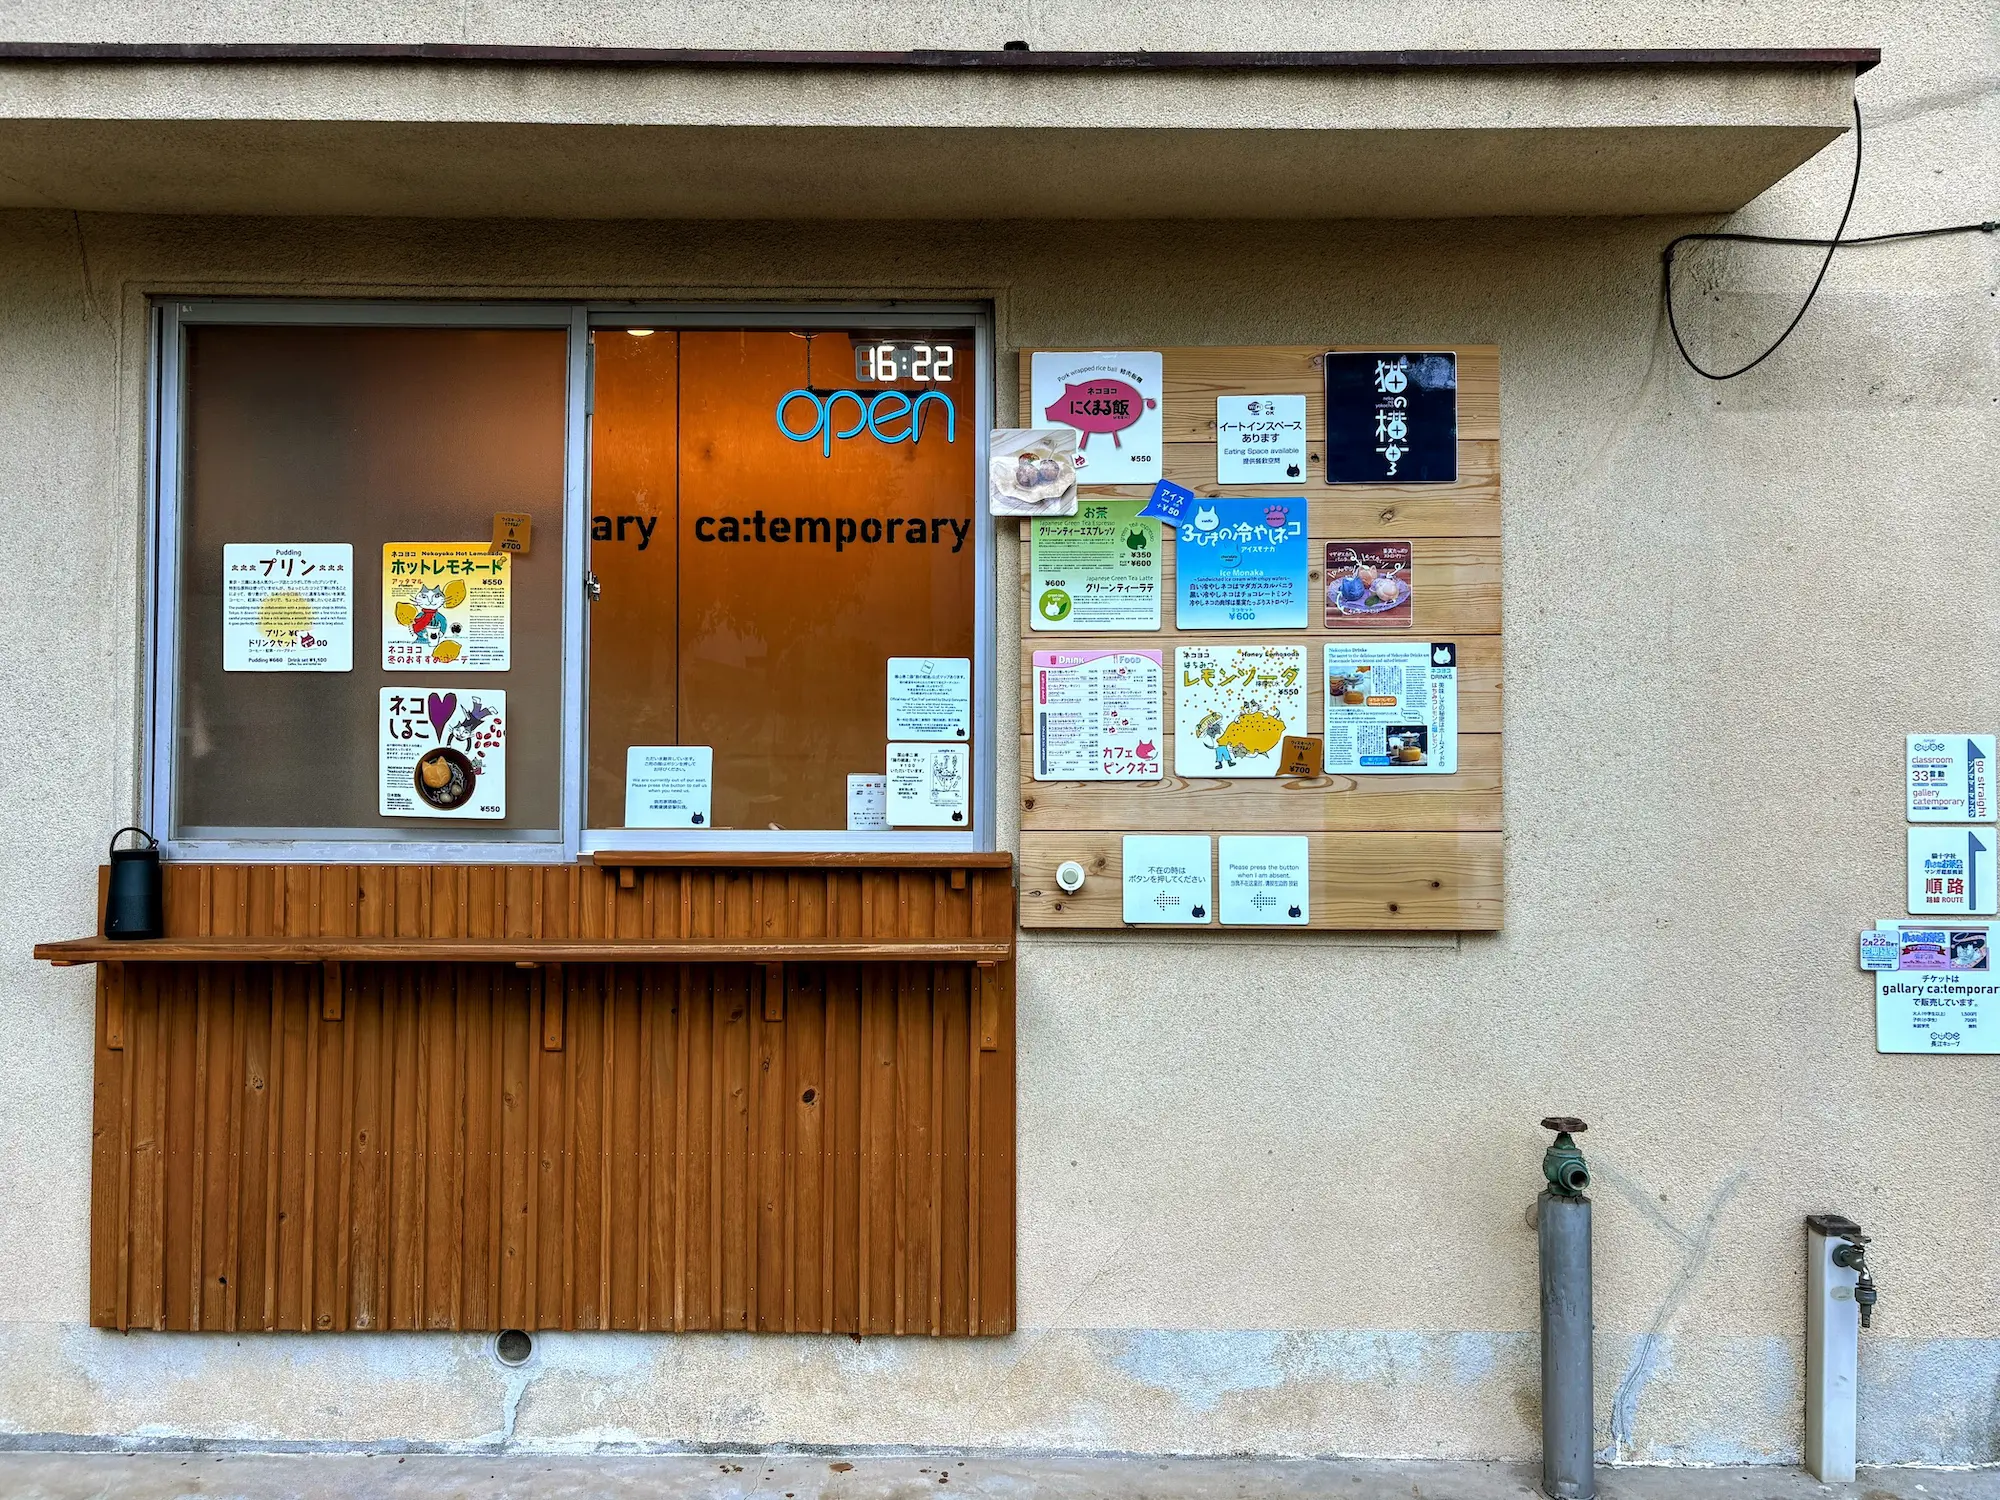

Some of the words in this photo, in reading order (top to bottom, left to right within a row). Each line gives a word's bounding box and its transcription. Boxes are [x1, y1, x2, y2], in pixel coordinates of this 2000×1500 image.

[869, 345, 954, 381] 16:22
[1057, 373, 1070, 382] Pork
[1070, 365, 1095, 376] wrapped
[1087, 387, 1117, 395] ネコヨコ
[1070, 399, 1130, 416] にくまる飯
[776, 390, 955, 457] open
[1219, 421, 1302, 432] イートインスペース
[1241, 433, 1280, 443] あります
[1224, 447, 1246, 455] Eating
[1247, 447, 1269, 455] Space
[1130, 455, 1152, 463] ¥550
[1161, 489, 1184, 505] アイス
[1084, 506, 1108, 519] お茶
[695, 510, 971, 553] ca:temporary
[1039, 527, 1116, 537] グリーンティーエスプレッソ
[1181, 521, 1301, 547] 3びきの冷やしネコ
[501, 542, 521, 550] ¥700
[276, 549, 302, 557] Pudding
[259, 558, 316, 577] プリン
[391, 559, 503, 575] ホットレモネード
[1232, 569, 1264, 577] Monaka
[1086, 583, 1154, 593] グリーンティーラテ
[1228, 612, 1256, 620] ¥600
[265, 629, 286, 637] プリン
[249, 639, 297, 647] ドリンクセット
[389, 646, 422, 654] ネコヨコ
[1183, 651, 1210, 659] ネコヨコ
[1184, 667, 1299, 688] レモンソーダ
[389, 695, 425, 715] ネコ
[389, 718, 429, 739] しるこ
[1914, 743, 1945, 751] cube
[1103, 746, 1133, 759] カフェ
[1912, 756, 1953, 764] classroom
[1104, 762, 1158, 775] ピンクネコ
[1289, 766, 1311, 774] ¥700
[1976, 760, 1984, 773] go
[1912, 770, 1929, 782] 33
[1913, 788, 1940, 798] gallery
[1976, 776, 1987, 817] straight
[480, 805, 501, 813] ¥550
[1147, 866, 1186, 874] 不在の時は
[1128, 875, 1206, 884] ボタンを押してください
[1925, 877, 1964, 895] 順路
[1921, 974, 1960, 983] チケットは
[1882, 983, 1924, 996] gallary
[1912, 998, 1979, 1007] で販売しています。
[1930, 1032, 1960, 1040] cube
